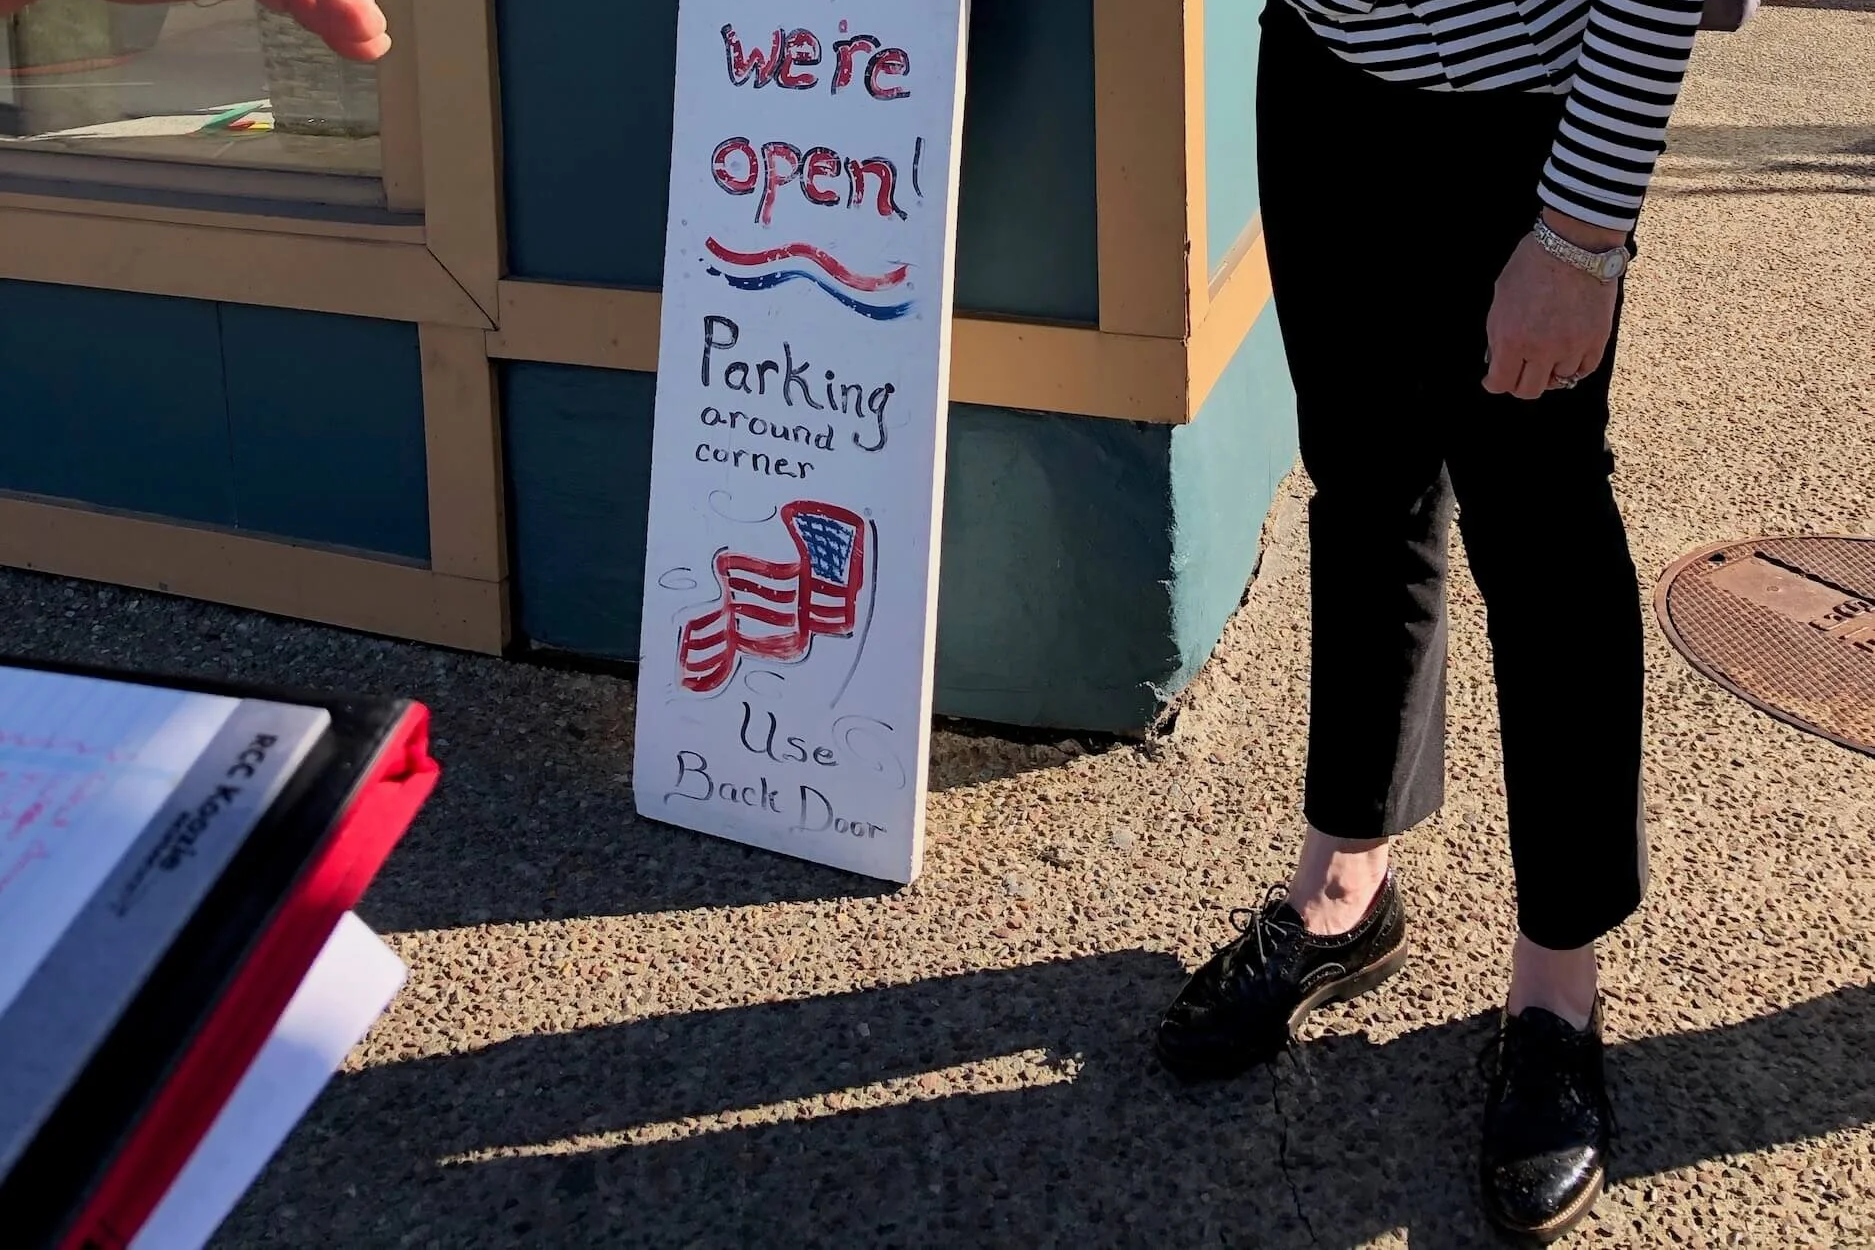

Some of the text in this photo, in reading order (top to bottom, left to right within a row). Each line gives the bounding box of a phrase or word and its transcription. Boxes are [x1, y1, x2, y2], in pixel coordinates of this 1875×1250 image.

[720, 18, 911, 100] we're
[711, 136, 926, 227] open!
[701, 315, 895, 451] Parking
[695, 443, 815, 479] corner
[701, 406, 835, 450] around
[740, 701, 839, 767] Use
[663, 750, 887, 839] Back Door
